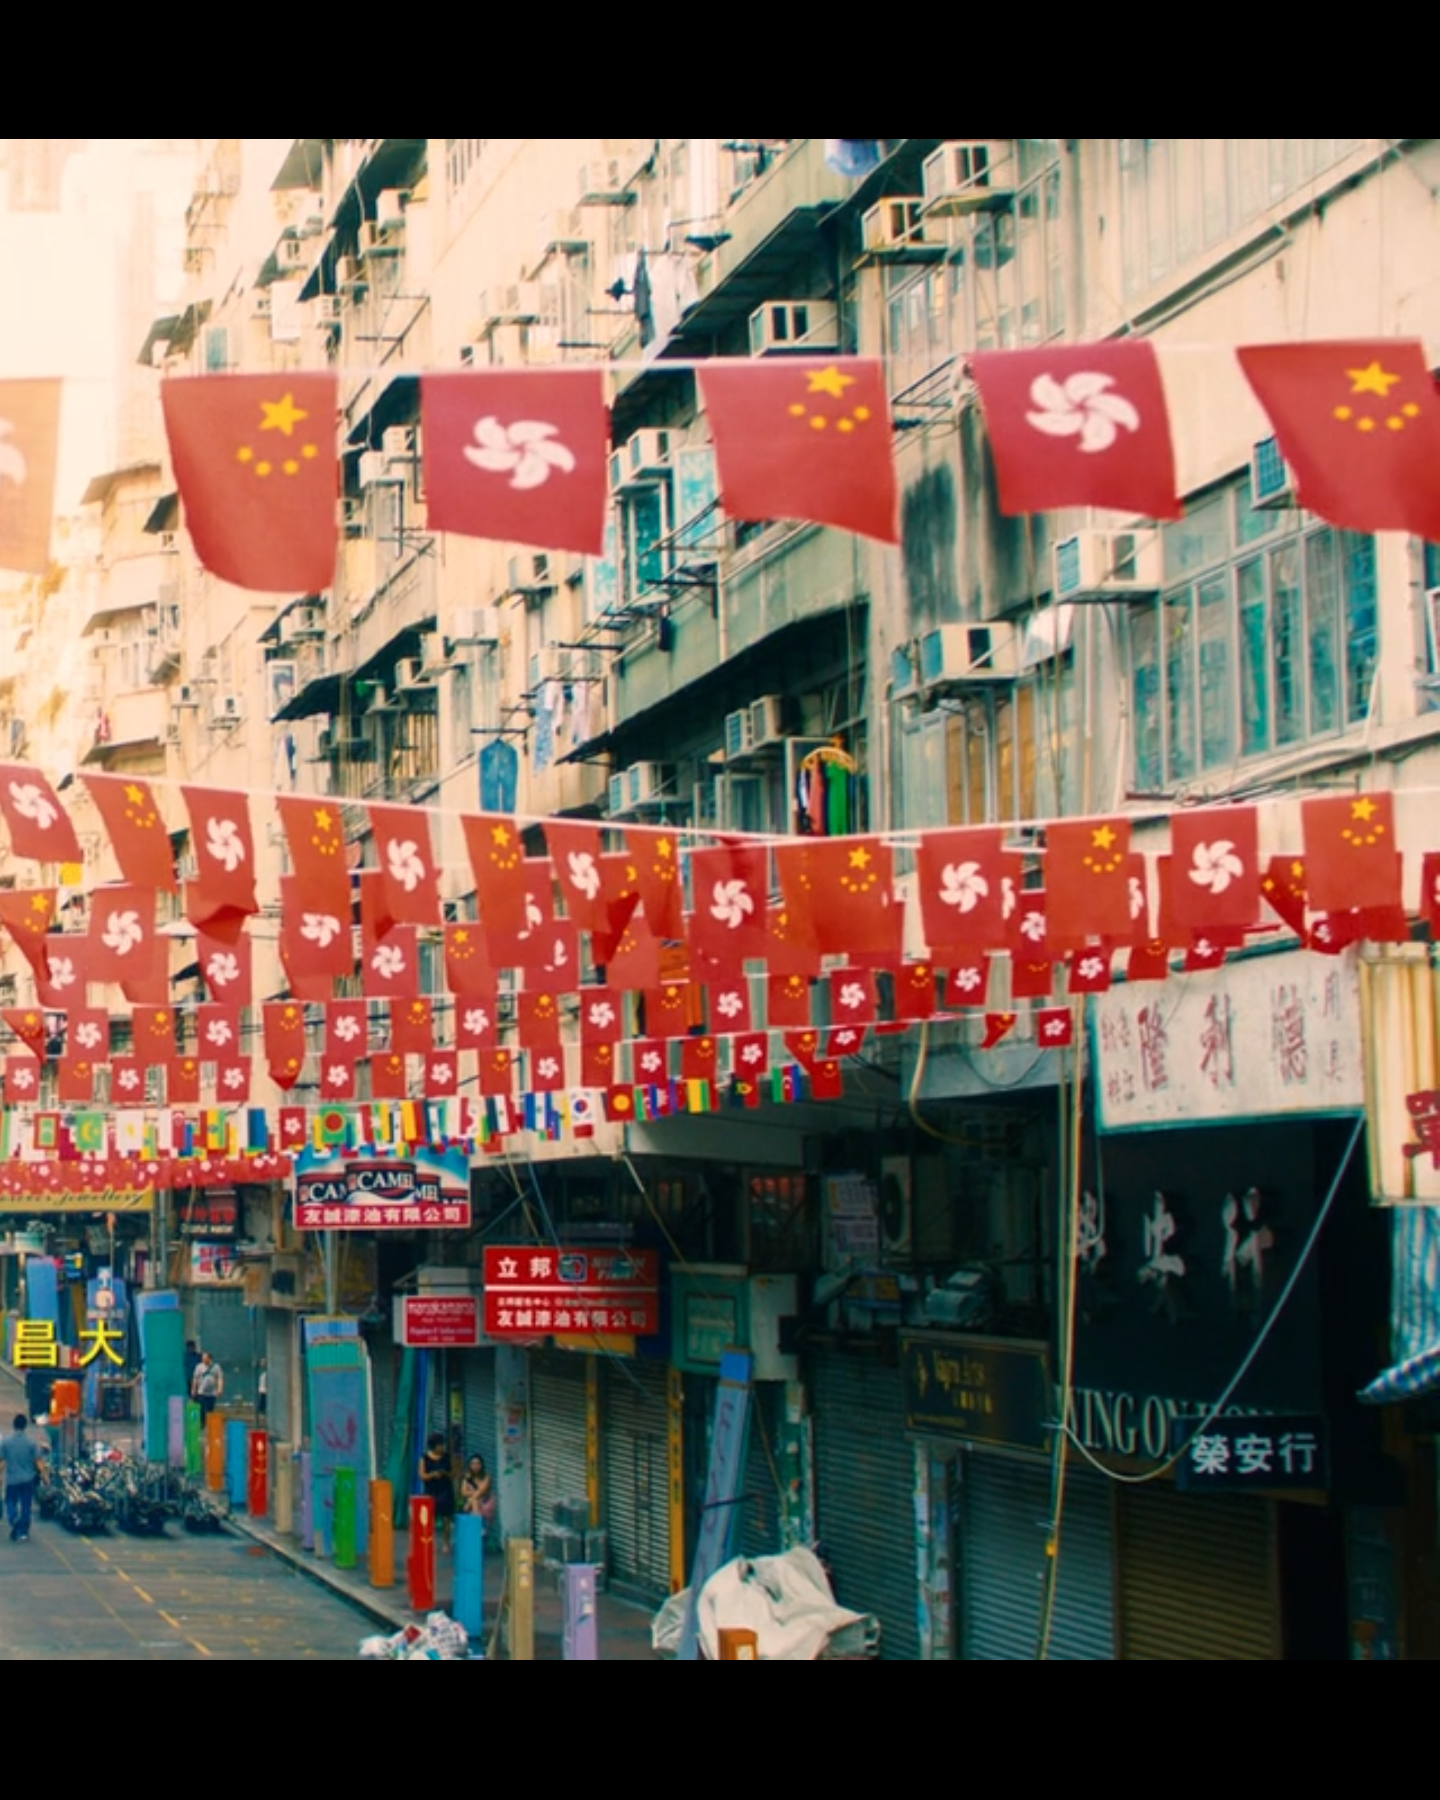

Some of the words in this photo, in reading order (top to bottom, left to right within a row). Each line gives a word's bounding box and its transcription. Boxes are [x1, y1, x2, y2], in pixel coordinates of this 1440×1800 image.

[496, 1256, 552, 1279] 立邦
[1189, 1431, 1318, 1475] 榮安行
